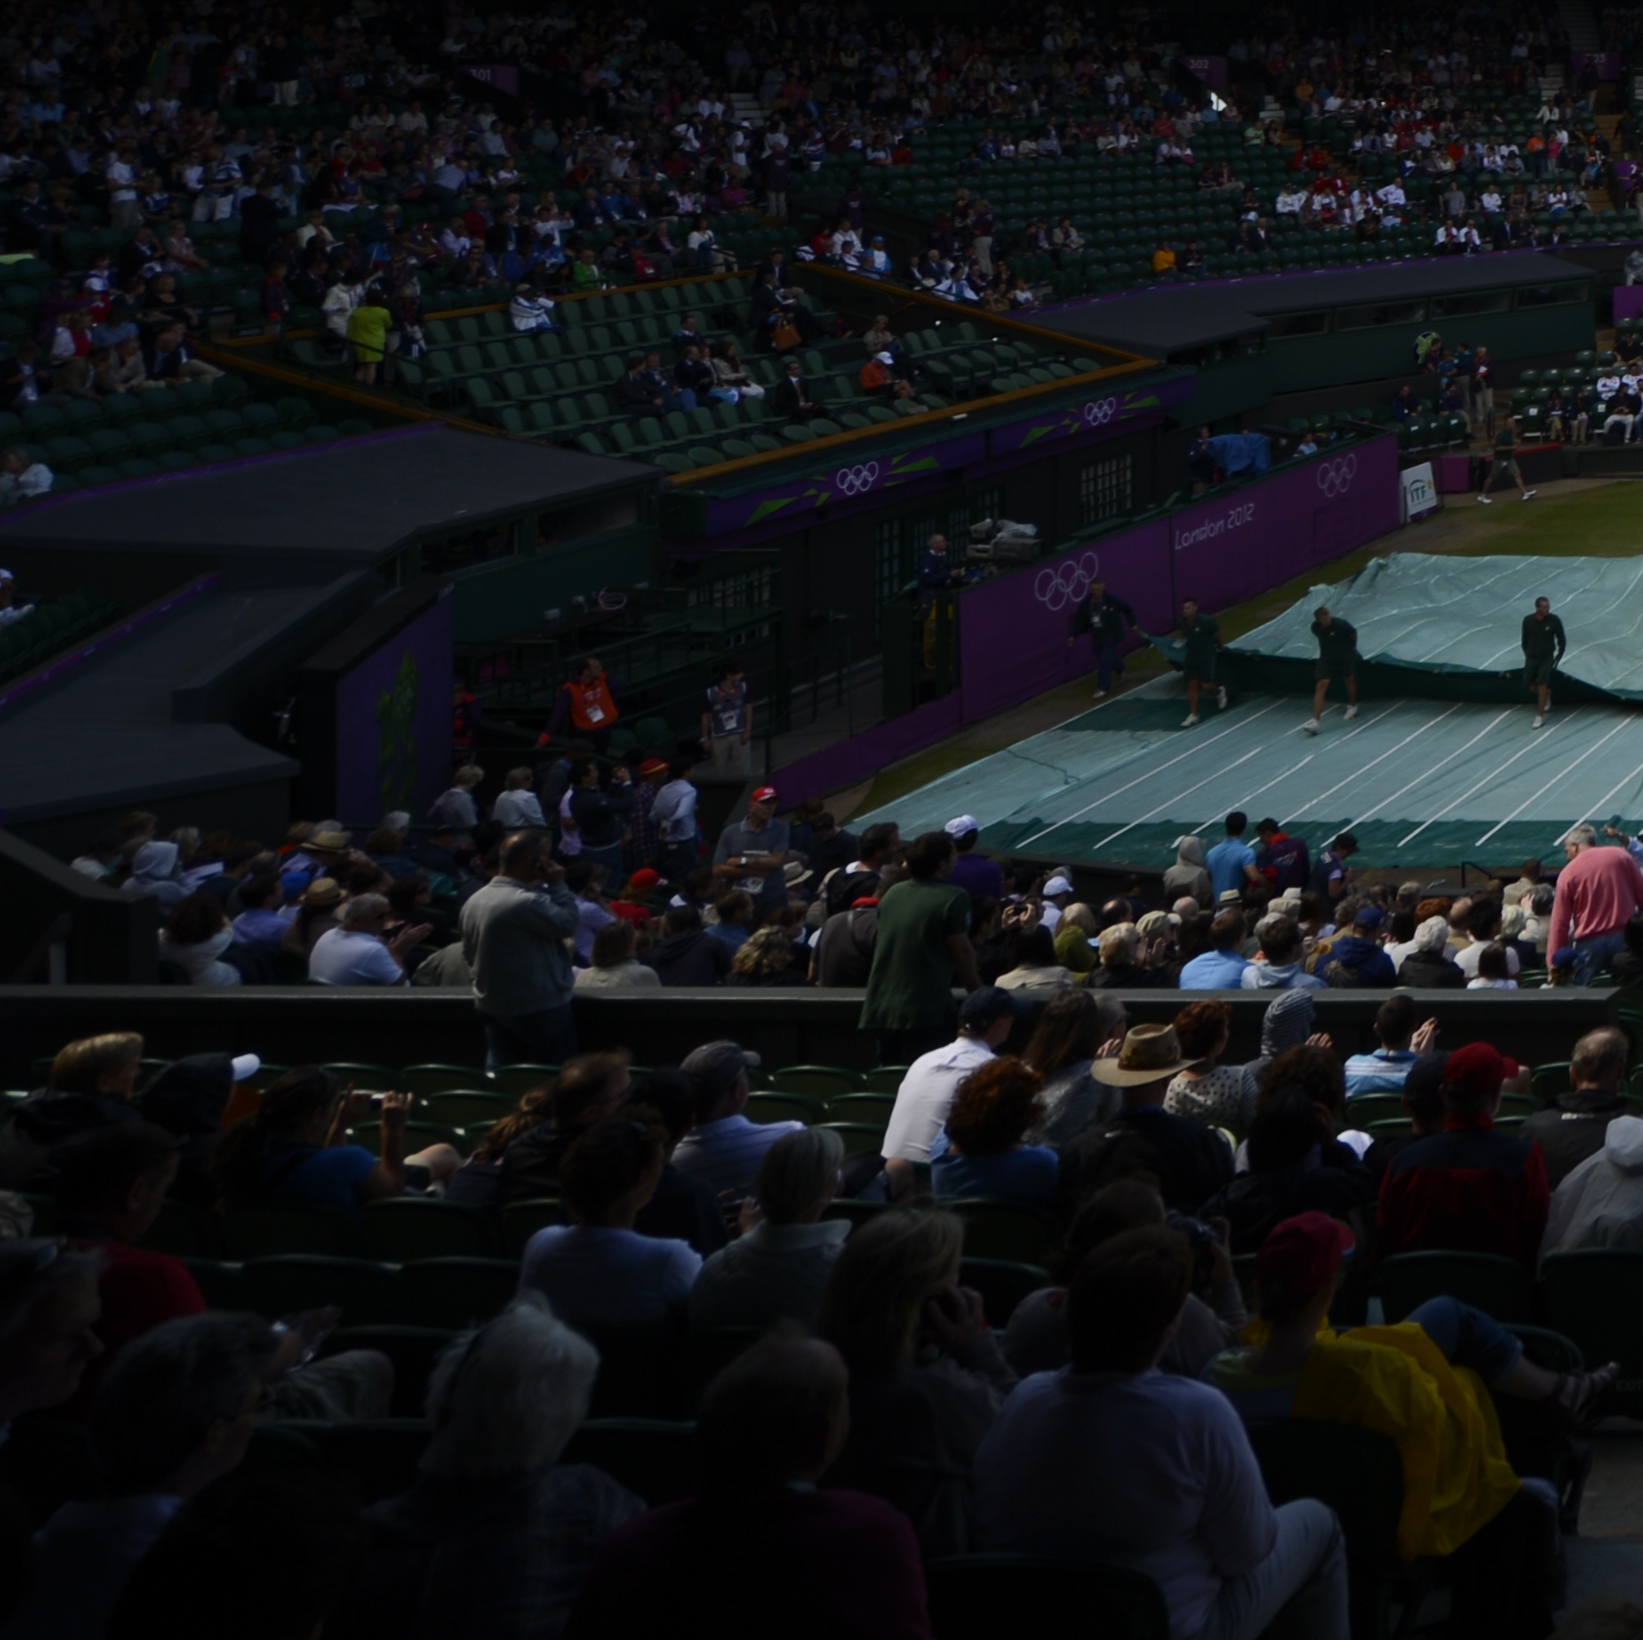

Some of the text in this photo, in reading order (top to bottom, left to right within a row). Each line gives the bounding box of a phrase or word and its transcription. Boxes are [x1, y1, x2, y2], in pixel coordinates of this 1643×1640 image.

[1189, 59, 1209, 69] 302
[1410, 485, 1426, 503] ITF
[1174, 503, 1255, 550] London 2012
